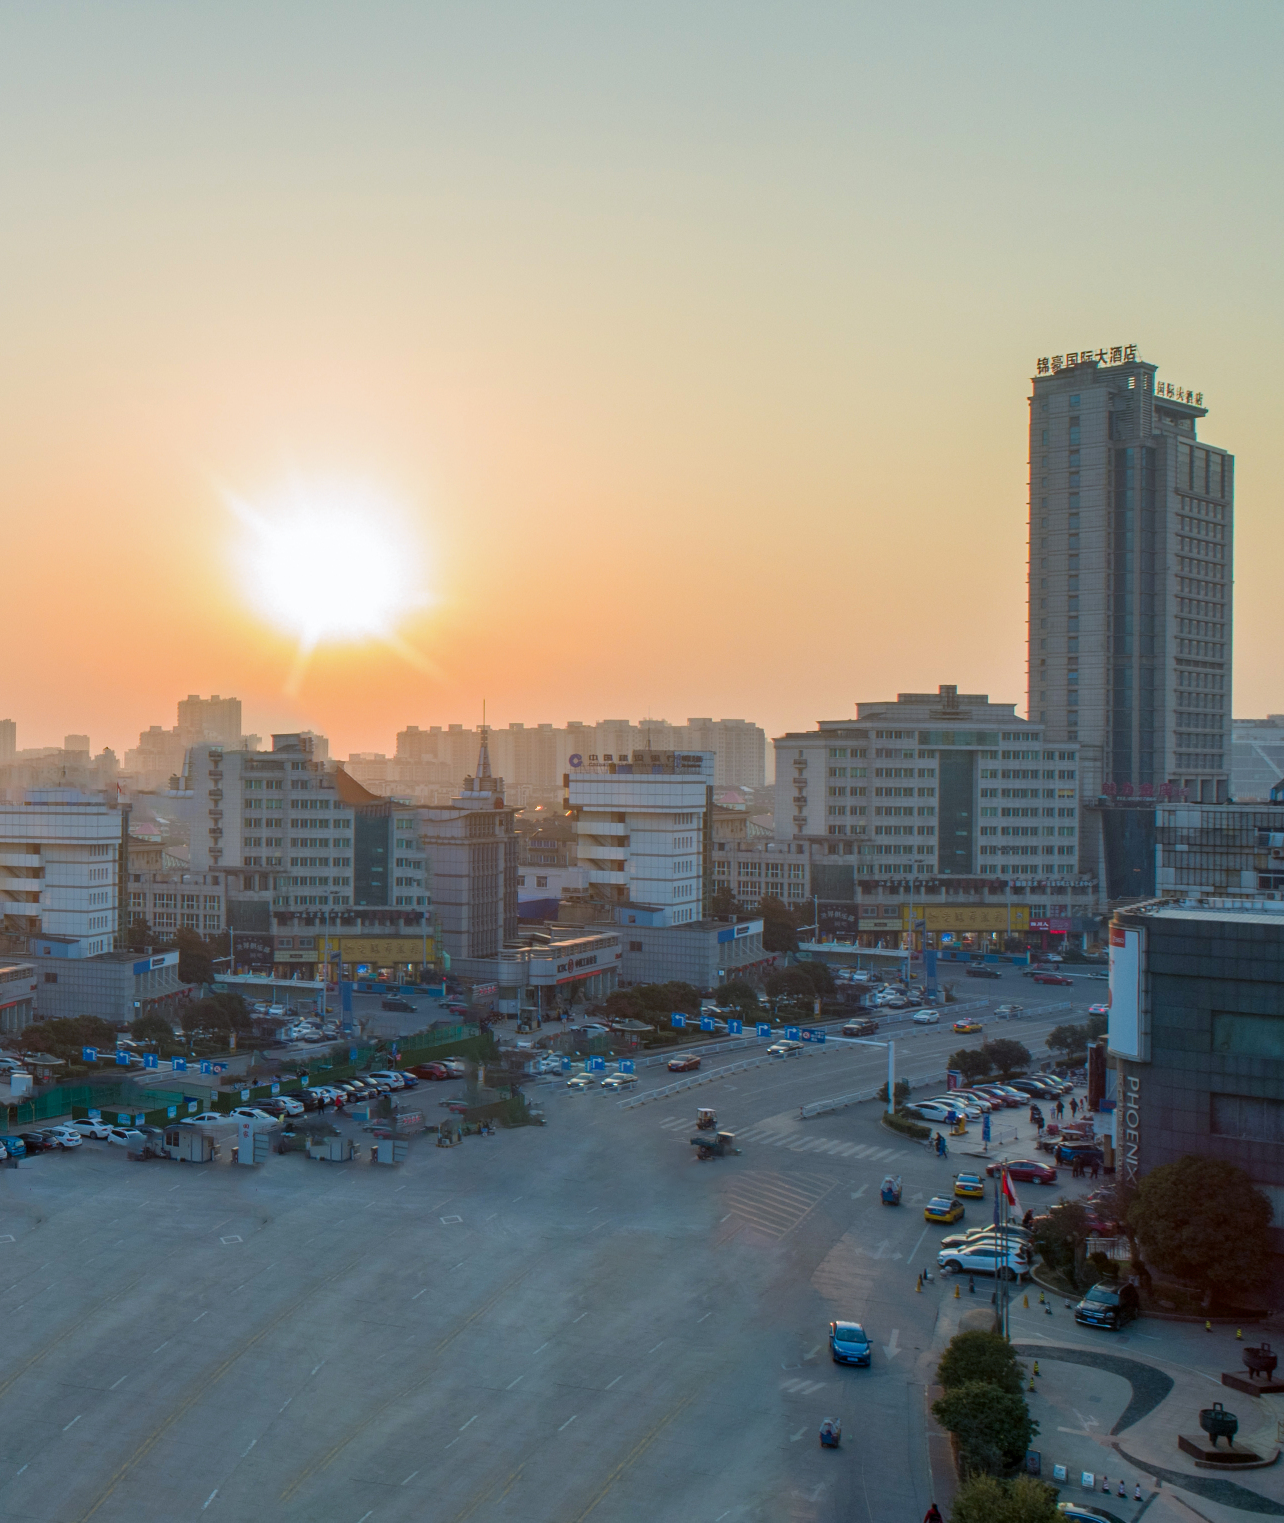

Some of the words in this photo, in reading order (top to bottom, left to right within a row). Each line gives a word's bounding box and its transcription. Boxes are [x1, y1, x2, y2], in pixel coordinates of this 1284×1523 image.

[1036, 344, 1138, 374] 锦豪国际大酒店
[1126, 1076, 1140, 1184] PHOENIX
